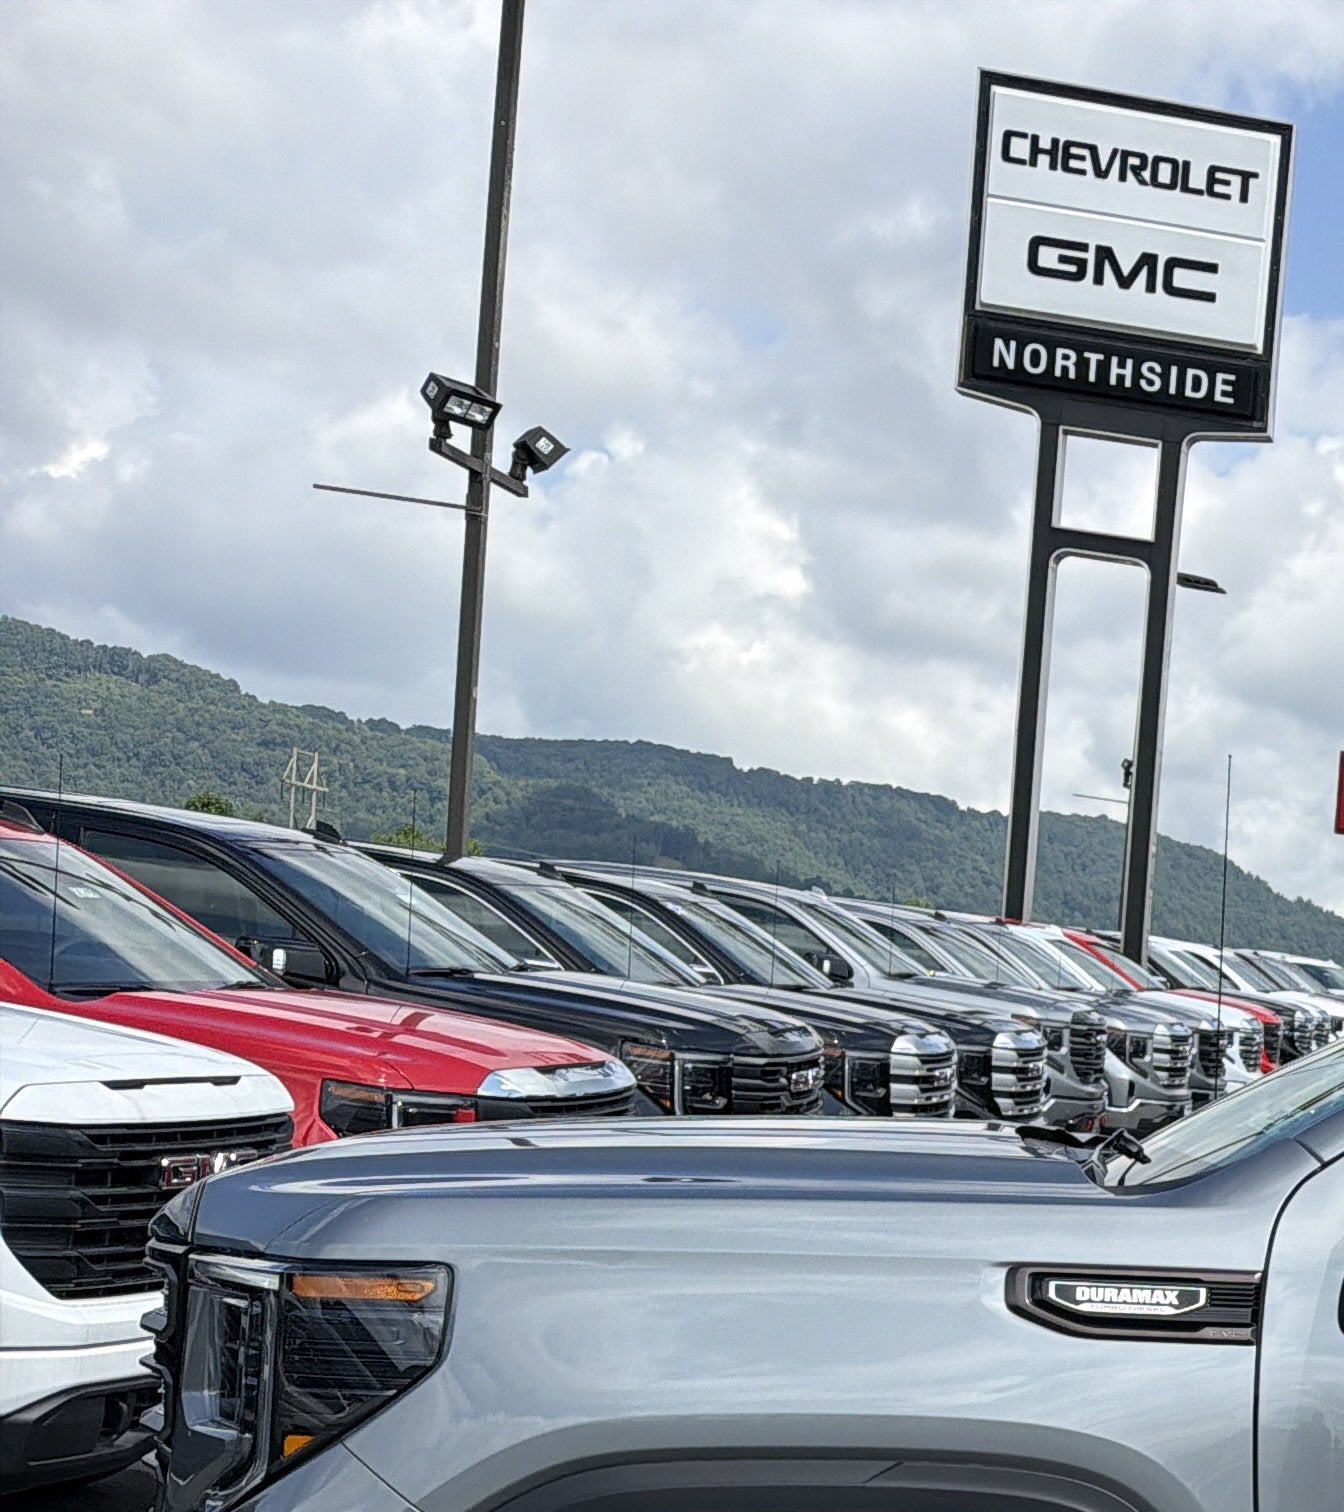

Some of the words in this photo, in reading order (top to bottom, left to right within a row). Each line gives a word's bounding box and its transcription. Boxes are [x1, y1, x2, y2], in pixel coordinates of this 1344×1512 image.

[1000, 128, 1260, 204] CHEVROLET
[1026, 235, 1219, 303] GMC
[992, 337, 1237, 404] NORTHSIDE
[1075, 1286, 1180, 1305] DURAMAX
